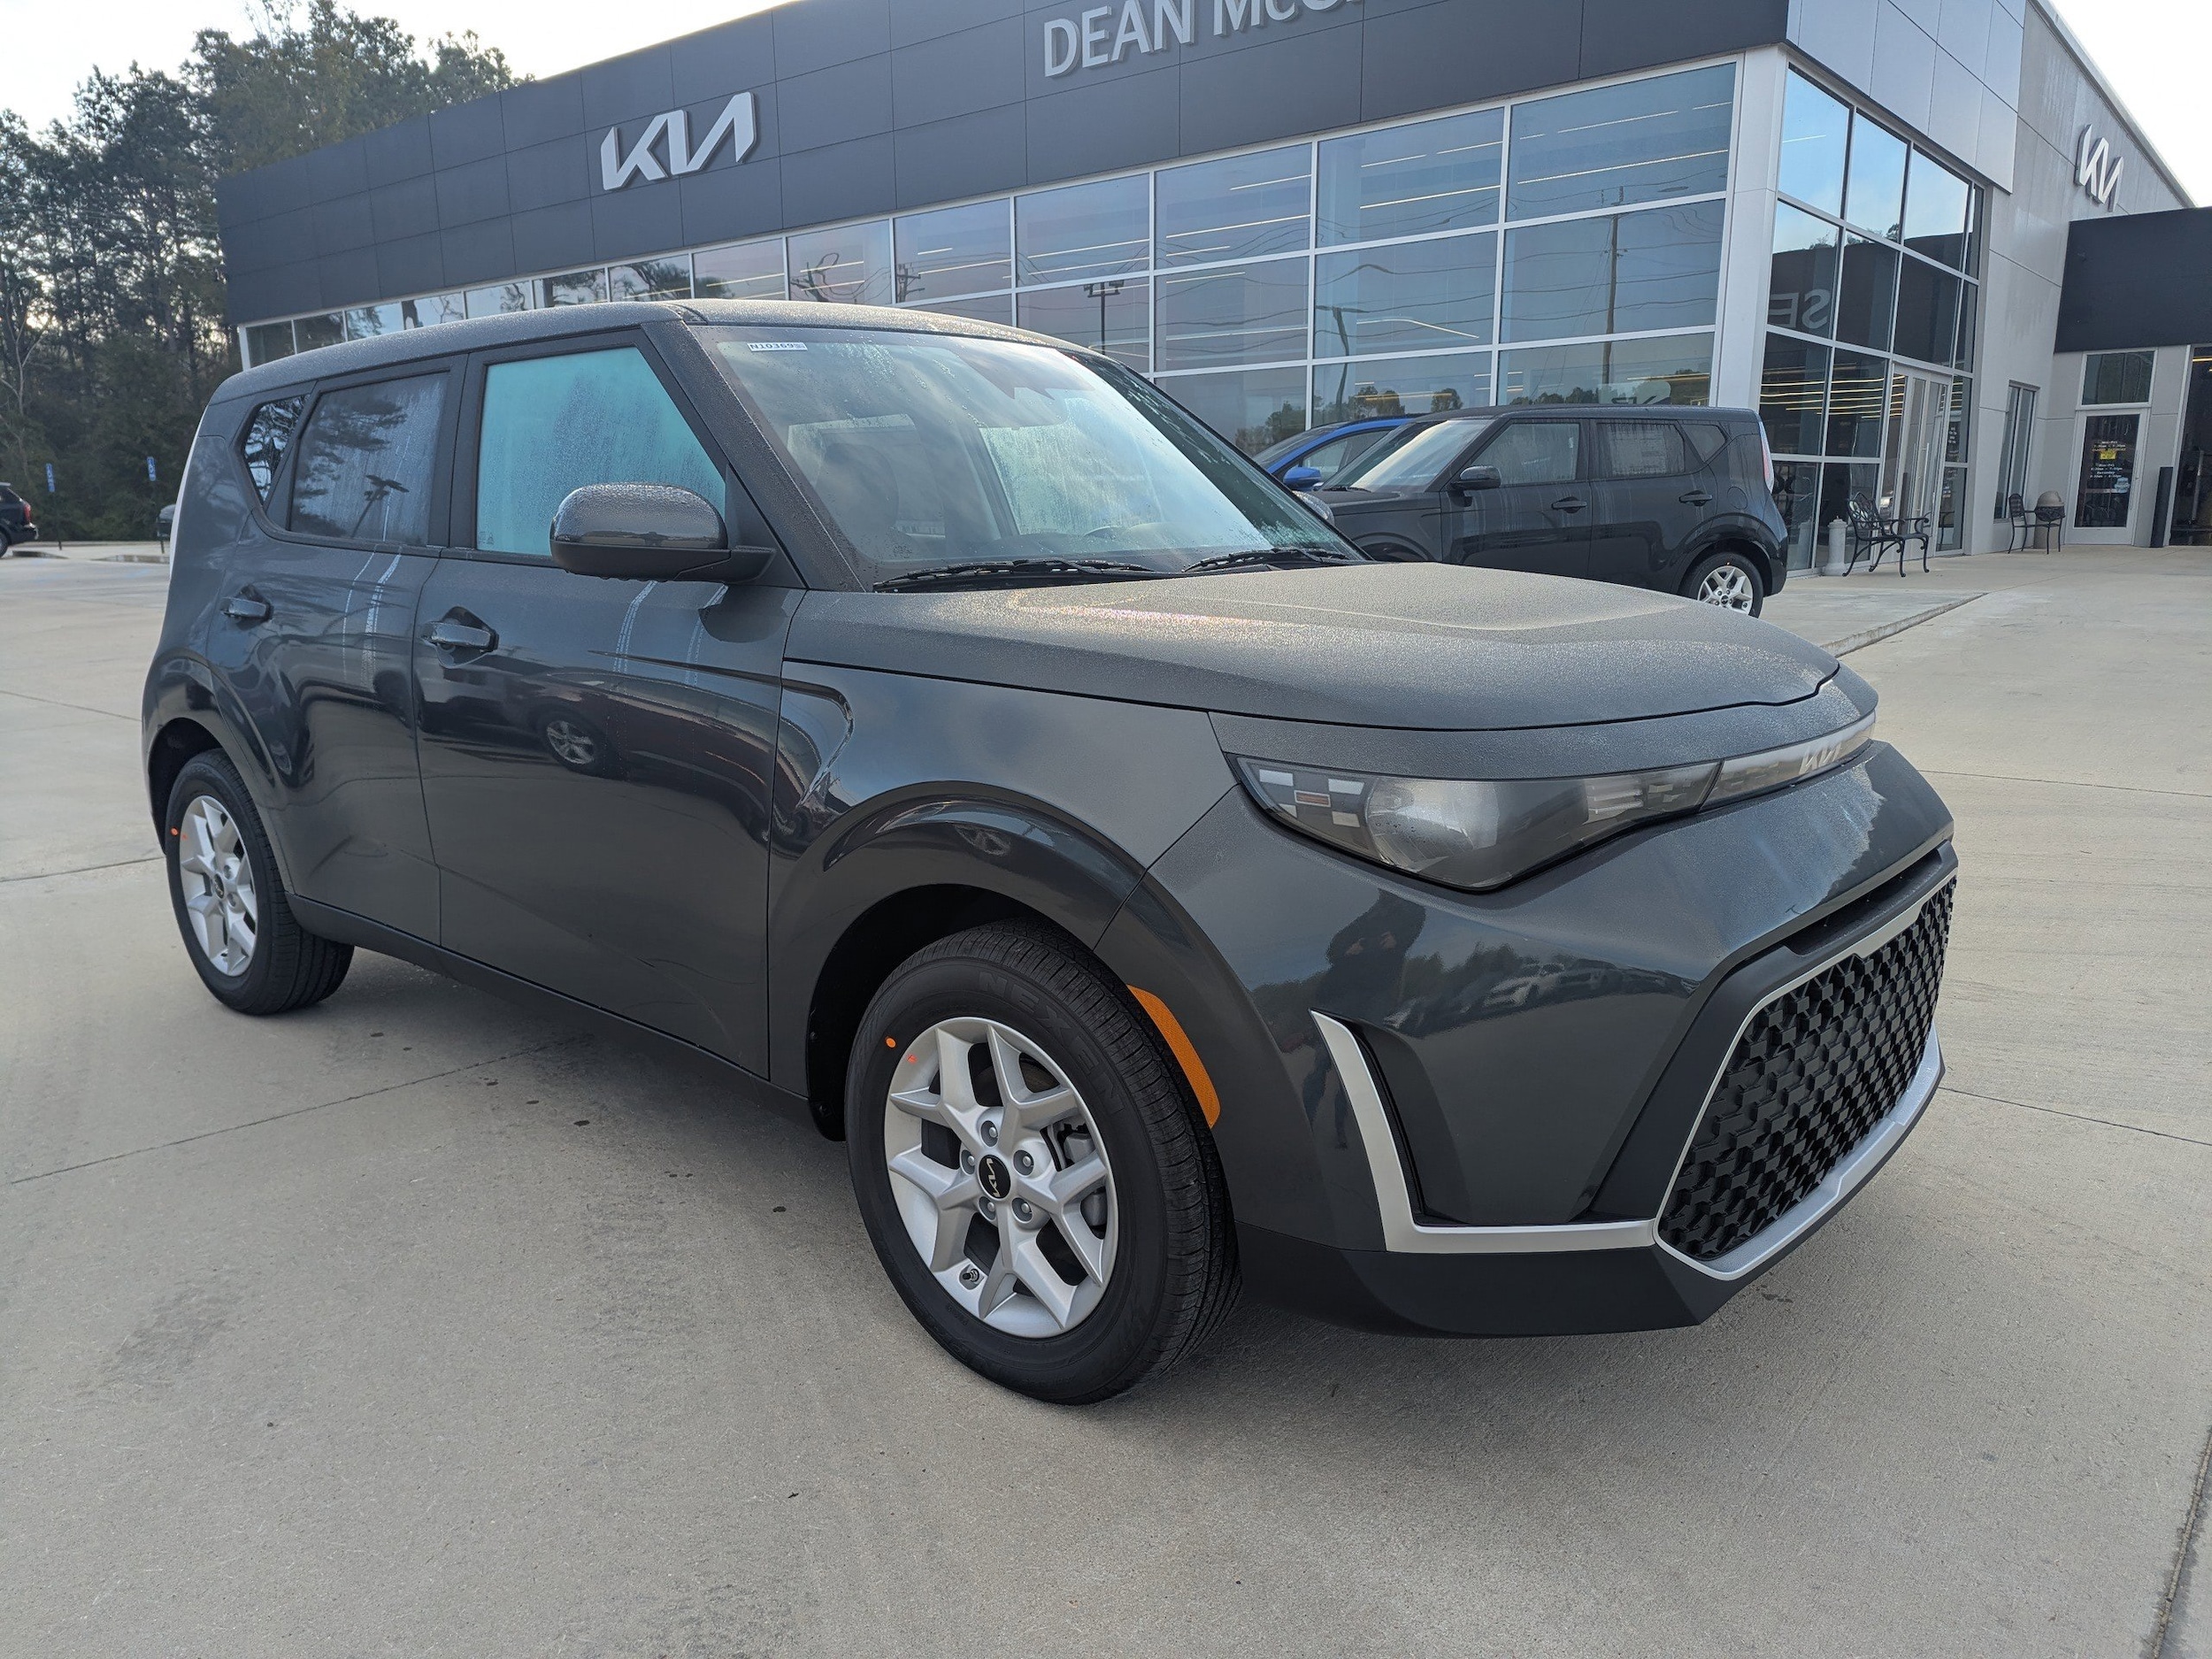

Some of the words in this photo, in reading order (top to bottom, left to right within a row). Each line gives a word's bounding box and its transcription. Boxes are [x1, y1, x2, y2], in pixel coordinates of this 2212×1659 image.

[1044, 0, 1195, 78] DEAN
[601, 91, 757, 190] KIA
[2074, 124, 2124, 212] KIA
